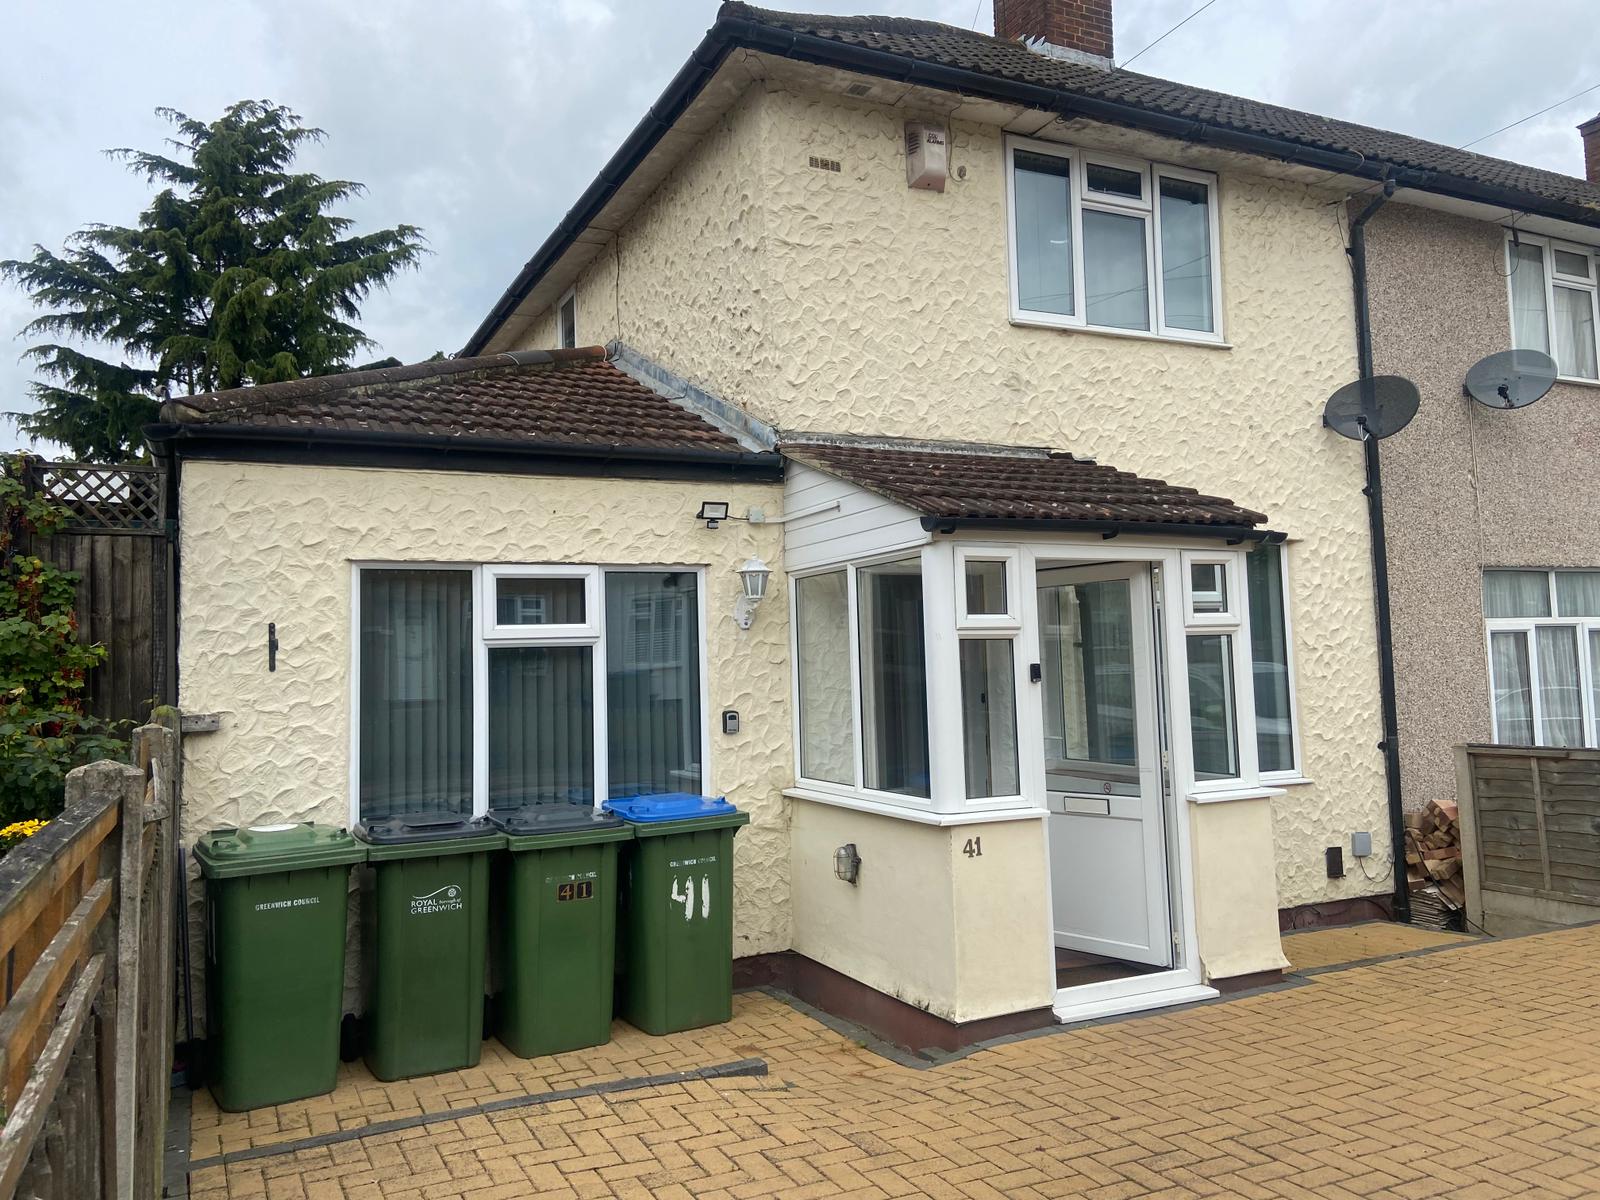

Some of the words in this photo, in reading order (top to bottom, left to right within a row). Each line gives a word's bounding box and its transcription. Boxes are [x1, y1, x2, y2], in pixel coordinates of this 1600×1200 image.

[962, 836, 983, 858] 41
[560, 882, 589, 900] 41
[671, 874, 711, 921] 41
[255, 900, 292, 911] GREENWICH
[411, 898, 438, 908] ROYAL
[411, 902, 463, 915] GREENWICH
